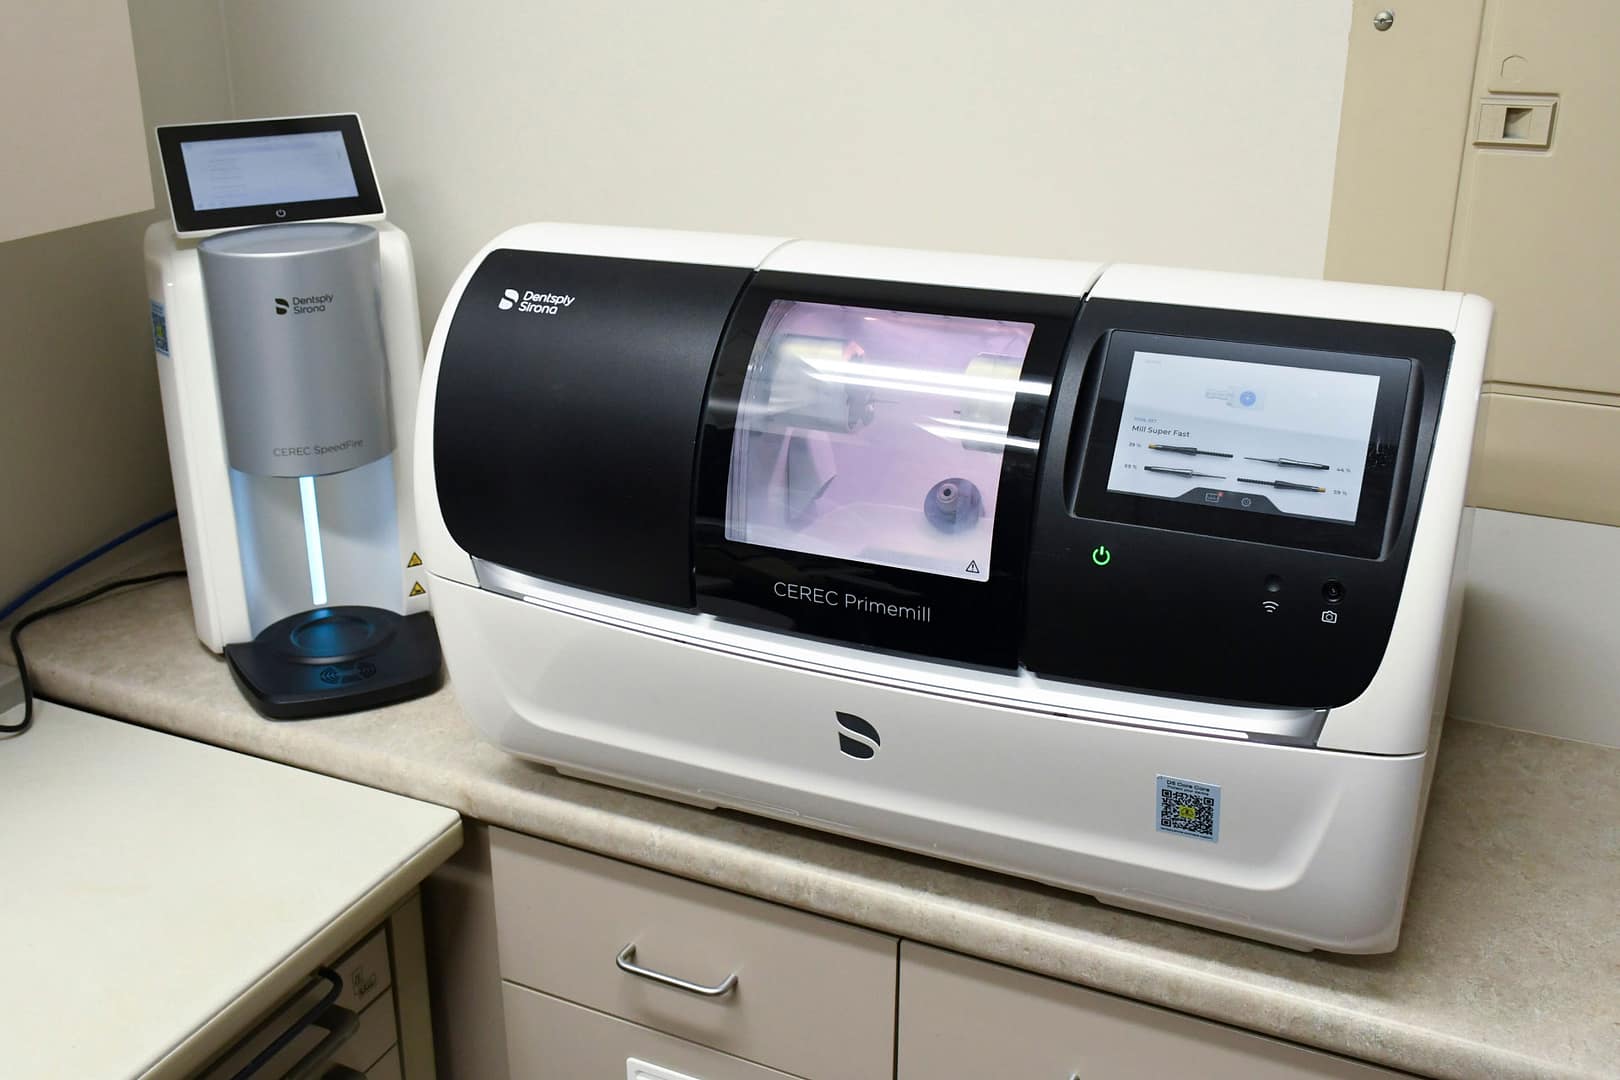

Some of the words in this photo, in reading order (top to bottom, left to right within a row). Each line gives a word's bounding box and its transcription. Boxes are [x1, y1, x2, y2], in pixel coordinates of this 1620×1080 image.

[292, 294, 334, 306] Dentsply
[523, 291, 575, 307] Dentsply
[293, 305, 326, 315] Sirona
[518, 301, 558, 315] Sirona
[1131, 424, 1147, 433] Mill
[1147, 426, 1172, 436] Super
[1173, 429, 1190, 438] Fast
[272, 446, 312, 457] CEREC
[313, 439, 364, 456] SpeedFire
[773, 581, 839, 606] CEREC
[845, 594, 931, 623] Primemill
